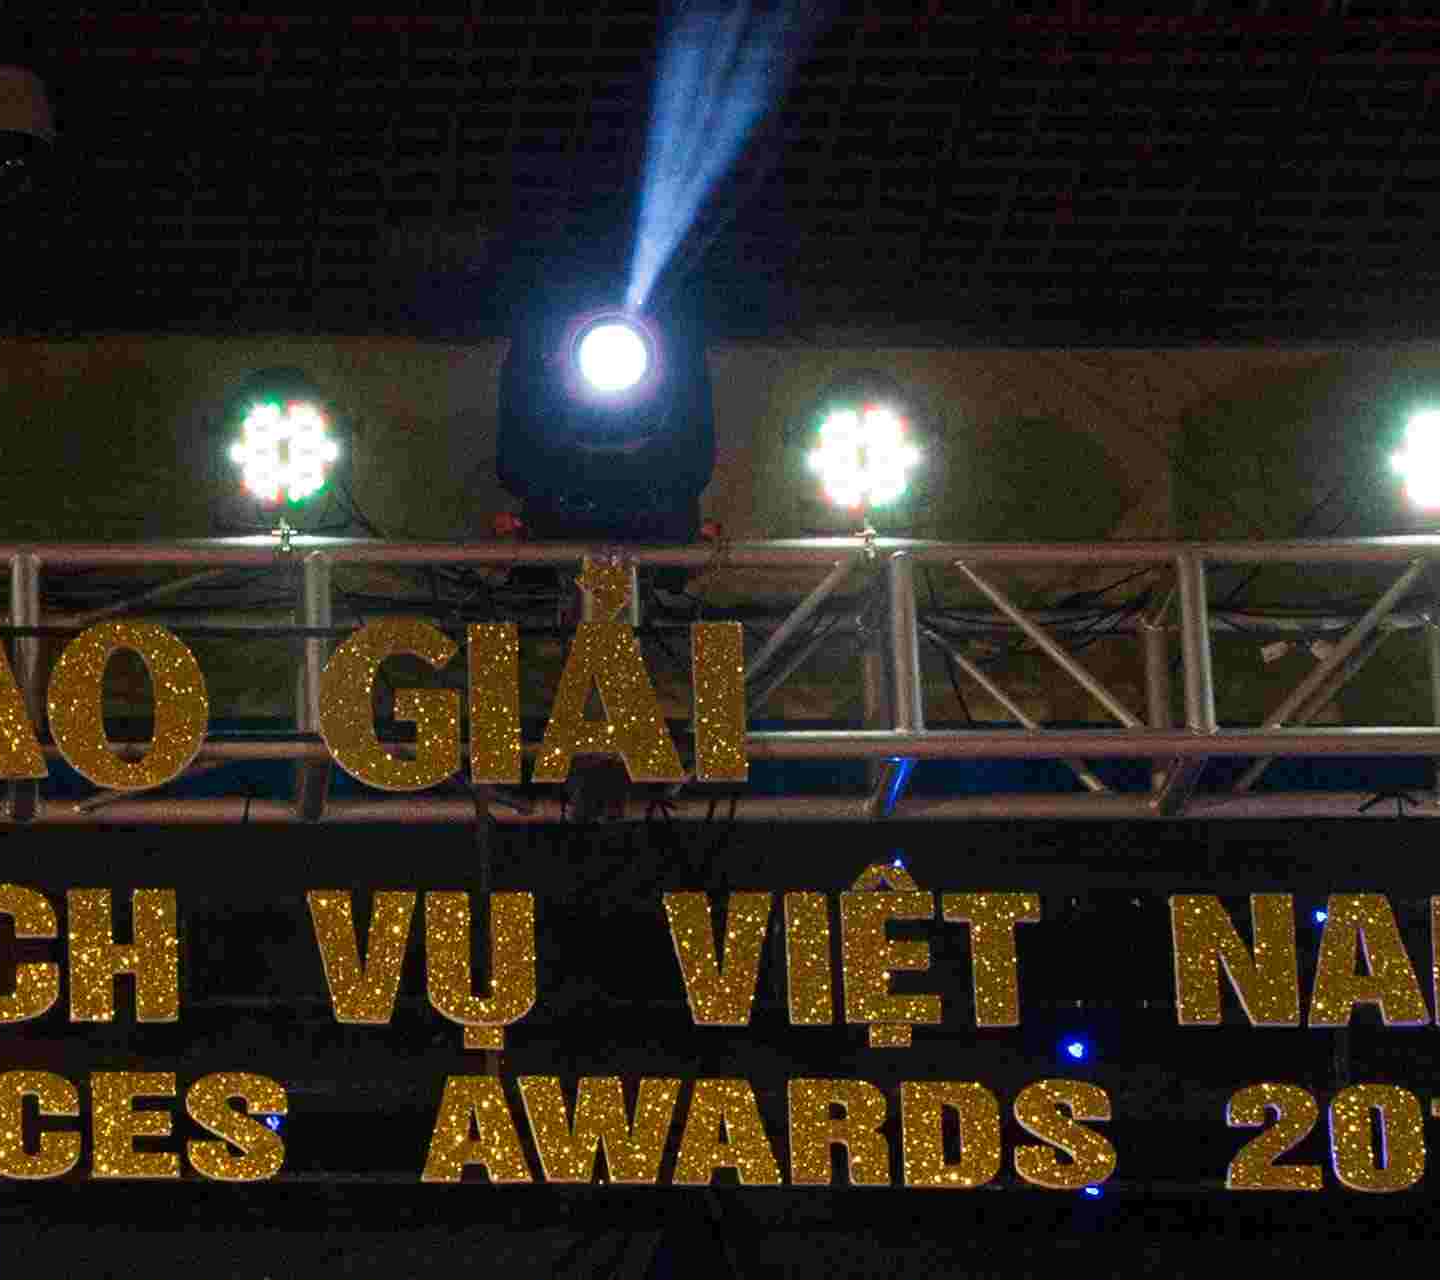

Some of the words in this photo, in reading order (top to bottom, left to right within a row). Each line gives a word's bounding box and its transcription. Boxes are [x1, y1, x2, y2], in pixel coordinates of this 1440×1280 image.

[319, 553, 749, 787] GIẢI
[305, 888, 538, 1050] VỤ
[664, 862, 1041, 1050] VIỆT
[421, 1075, 1120, 1190] AWARDS
